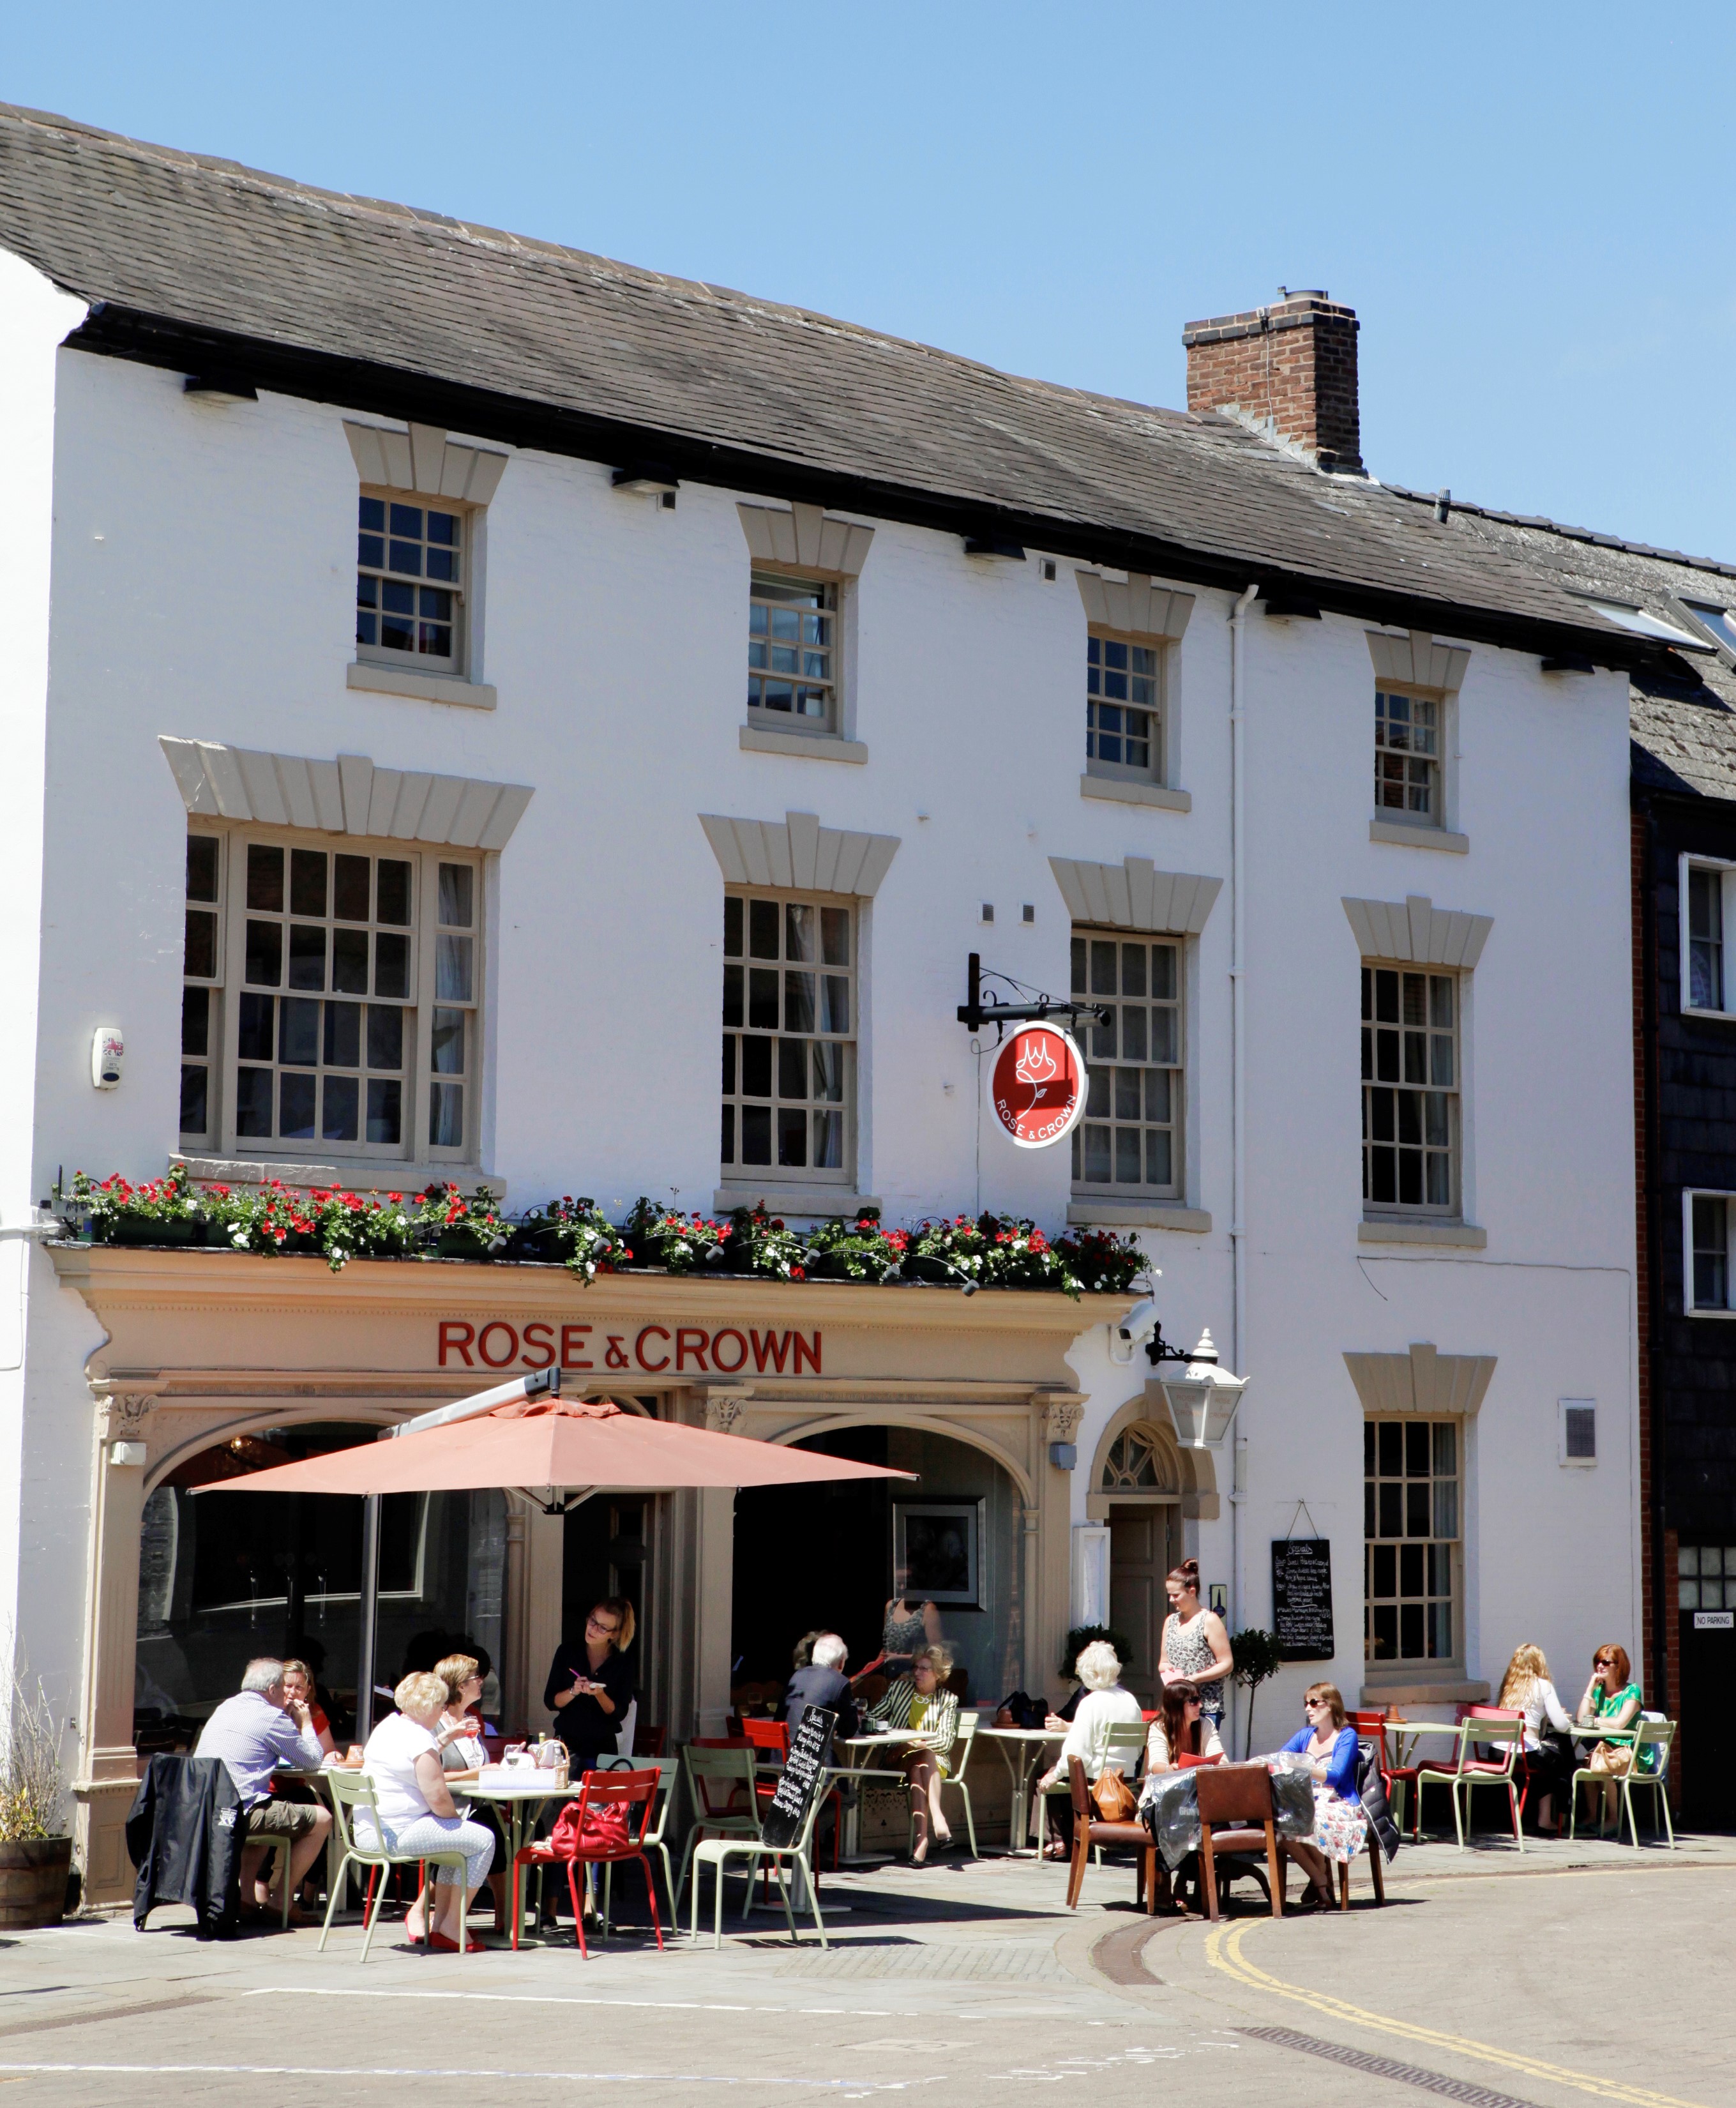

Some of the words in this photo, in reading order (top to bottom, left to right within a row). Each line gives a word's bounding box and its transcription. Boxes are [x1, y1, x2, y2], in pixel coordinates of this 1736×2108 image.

[997, 1098, 1025, 1137] ROSE
[1028, 1130, 1036, 1140] &
[1038, 1094, 1076, 1139] CROWN
[438, 1321, 593, 1368] ROSE
[605, 1336, 630, 1369] &
[635, 1326, 822, 1374] CROWN
[1287, 1541, 1313, 1556] Specials
[1697, 1616, 1705, 1625] NO
[1707, 1616, 1730, 1625] PARKING
